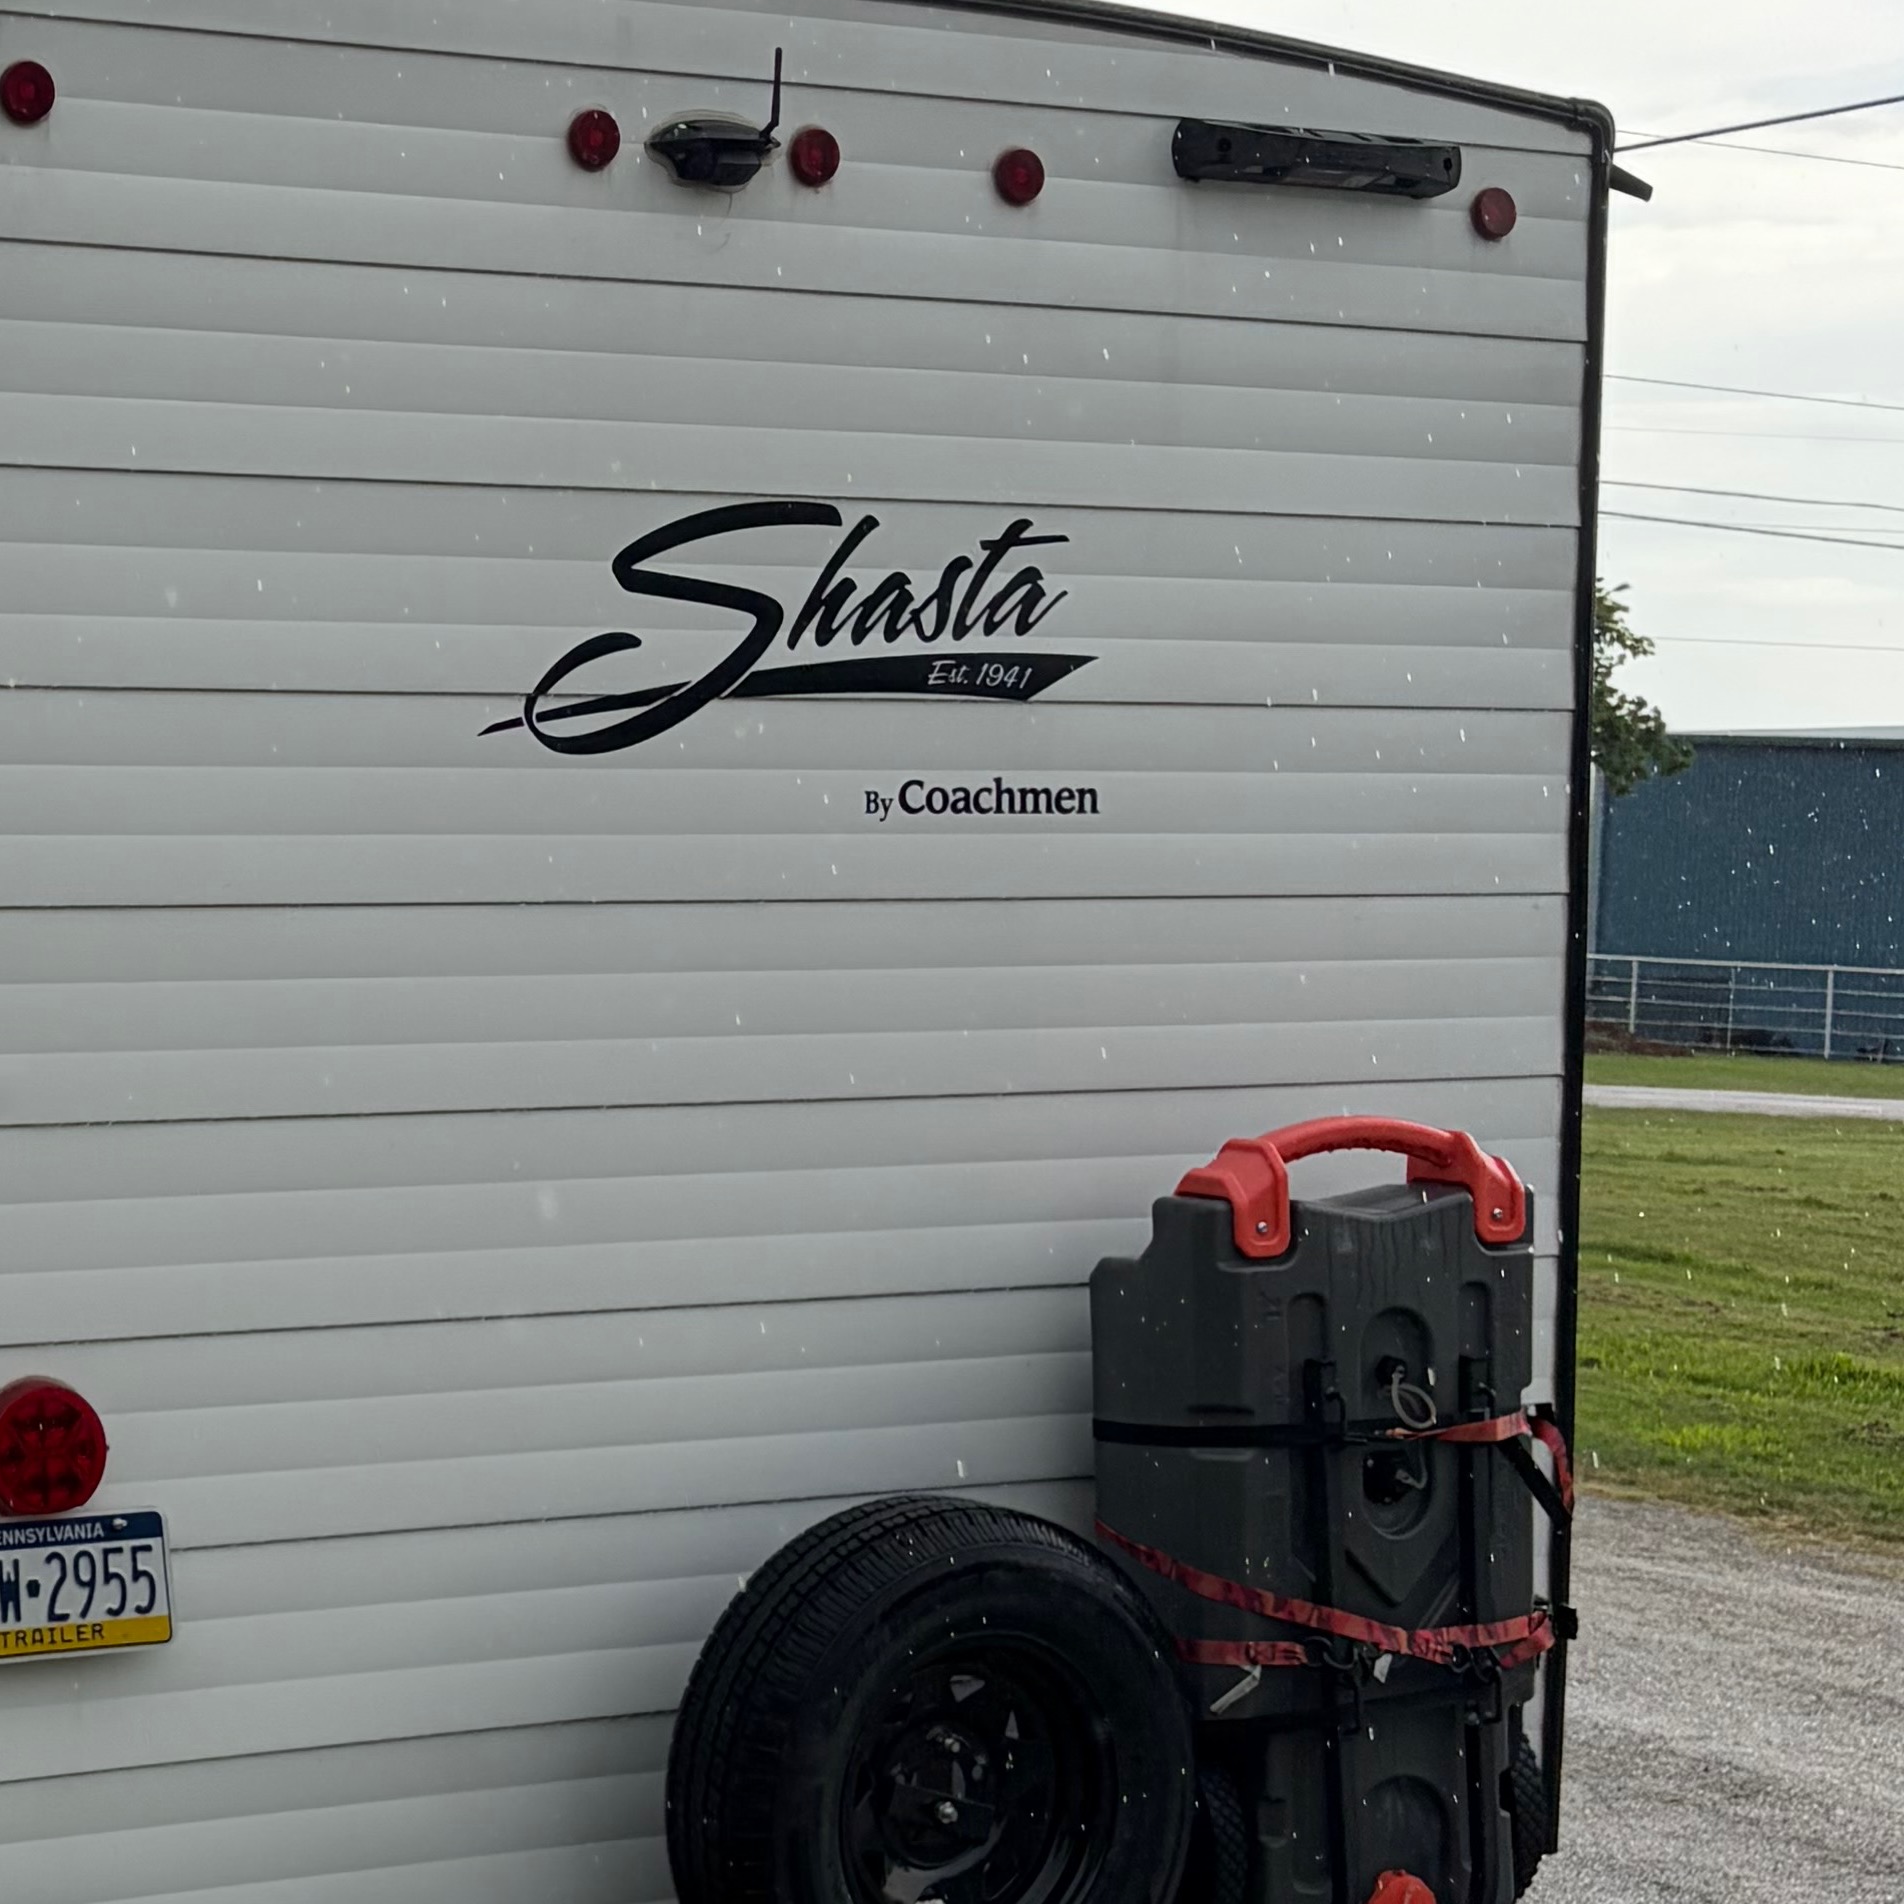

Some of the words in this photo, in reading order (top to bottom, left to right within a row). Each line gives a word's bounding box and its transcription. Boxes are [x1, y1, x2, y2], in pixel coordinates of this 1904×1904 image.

[524, 500, 1070, 755] Shasta
[927, 659, 969, 686] Est.
[975, 662, 1033, 689] 1941
[864, 790, 894, 822] By
[898, 776, 1100, 815] Coachmen
[0, 1623, 105, 1650] TRAILER
